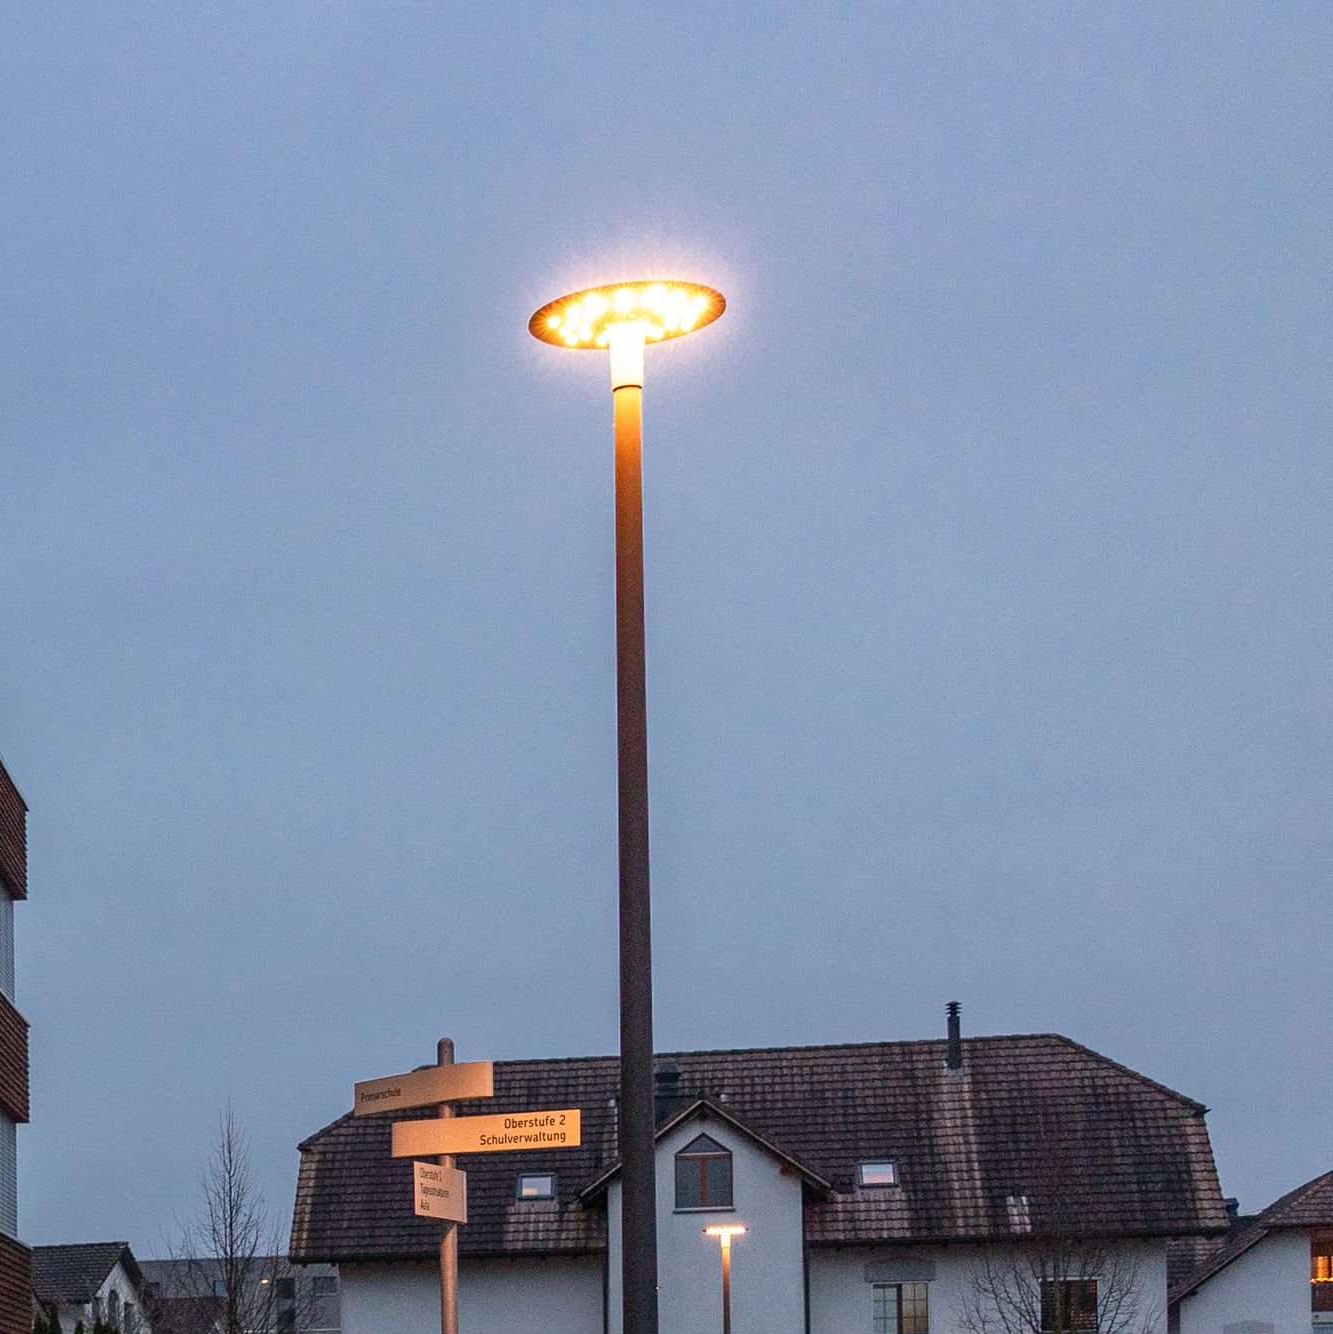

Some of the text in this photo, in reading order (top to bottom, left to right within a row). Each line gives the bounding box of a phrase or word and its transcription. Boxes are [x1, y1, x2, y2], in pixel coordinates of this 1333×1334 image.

[360, 1087, 401, 1103] Primarschule
[504, 1114, 566, 1129] Oberstufe 2
[479, 1131, 566, 1146] Schulverwaltung
[420, 1166, 438, 1181] Oberstufe
